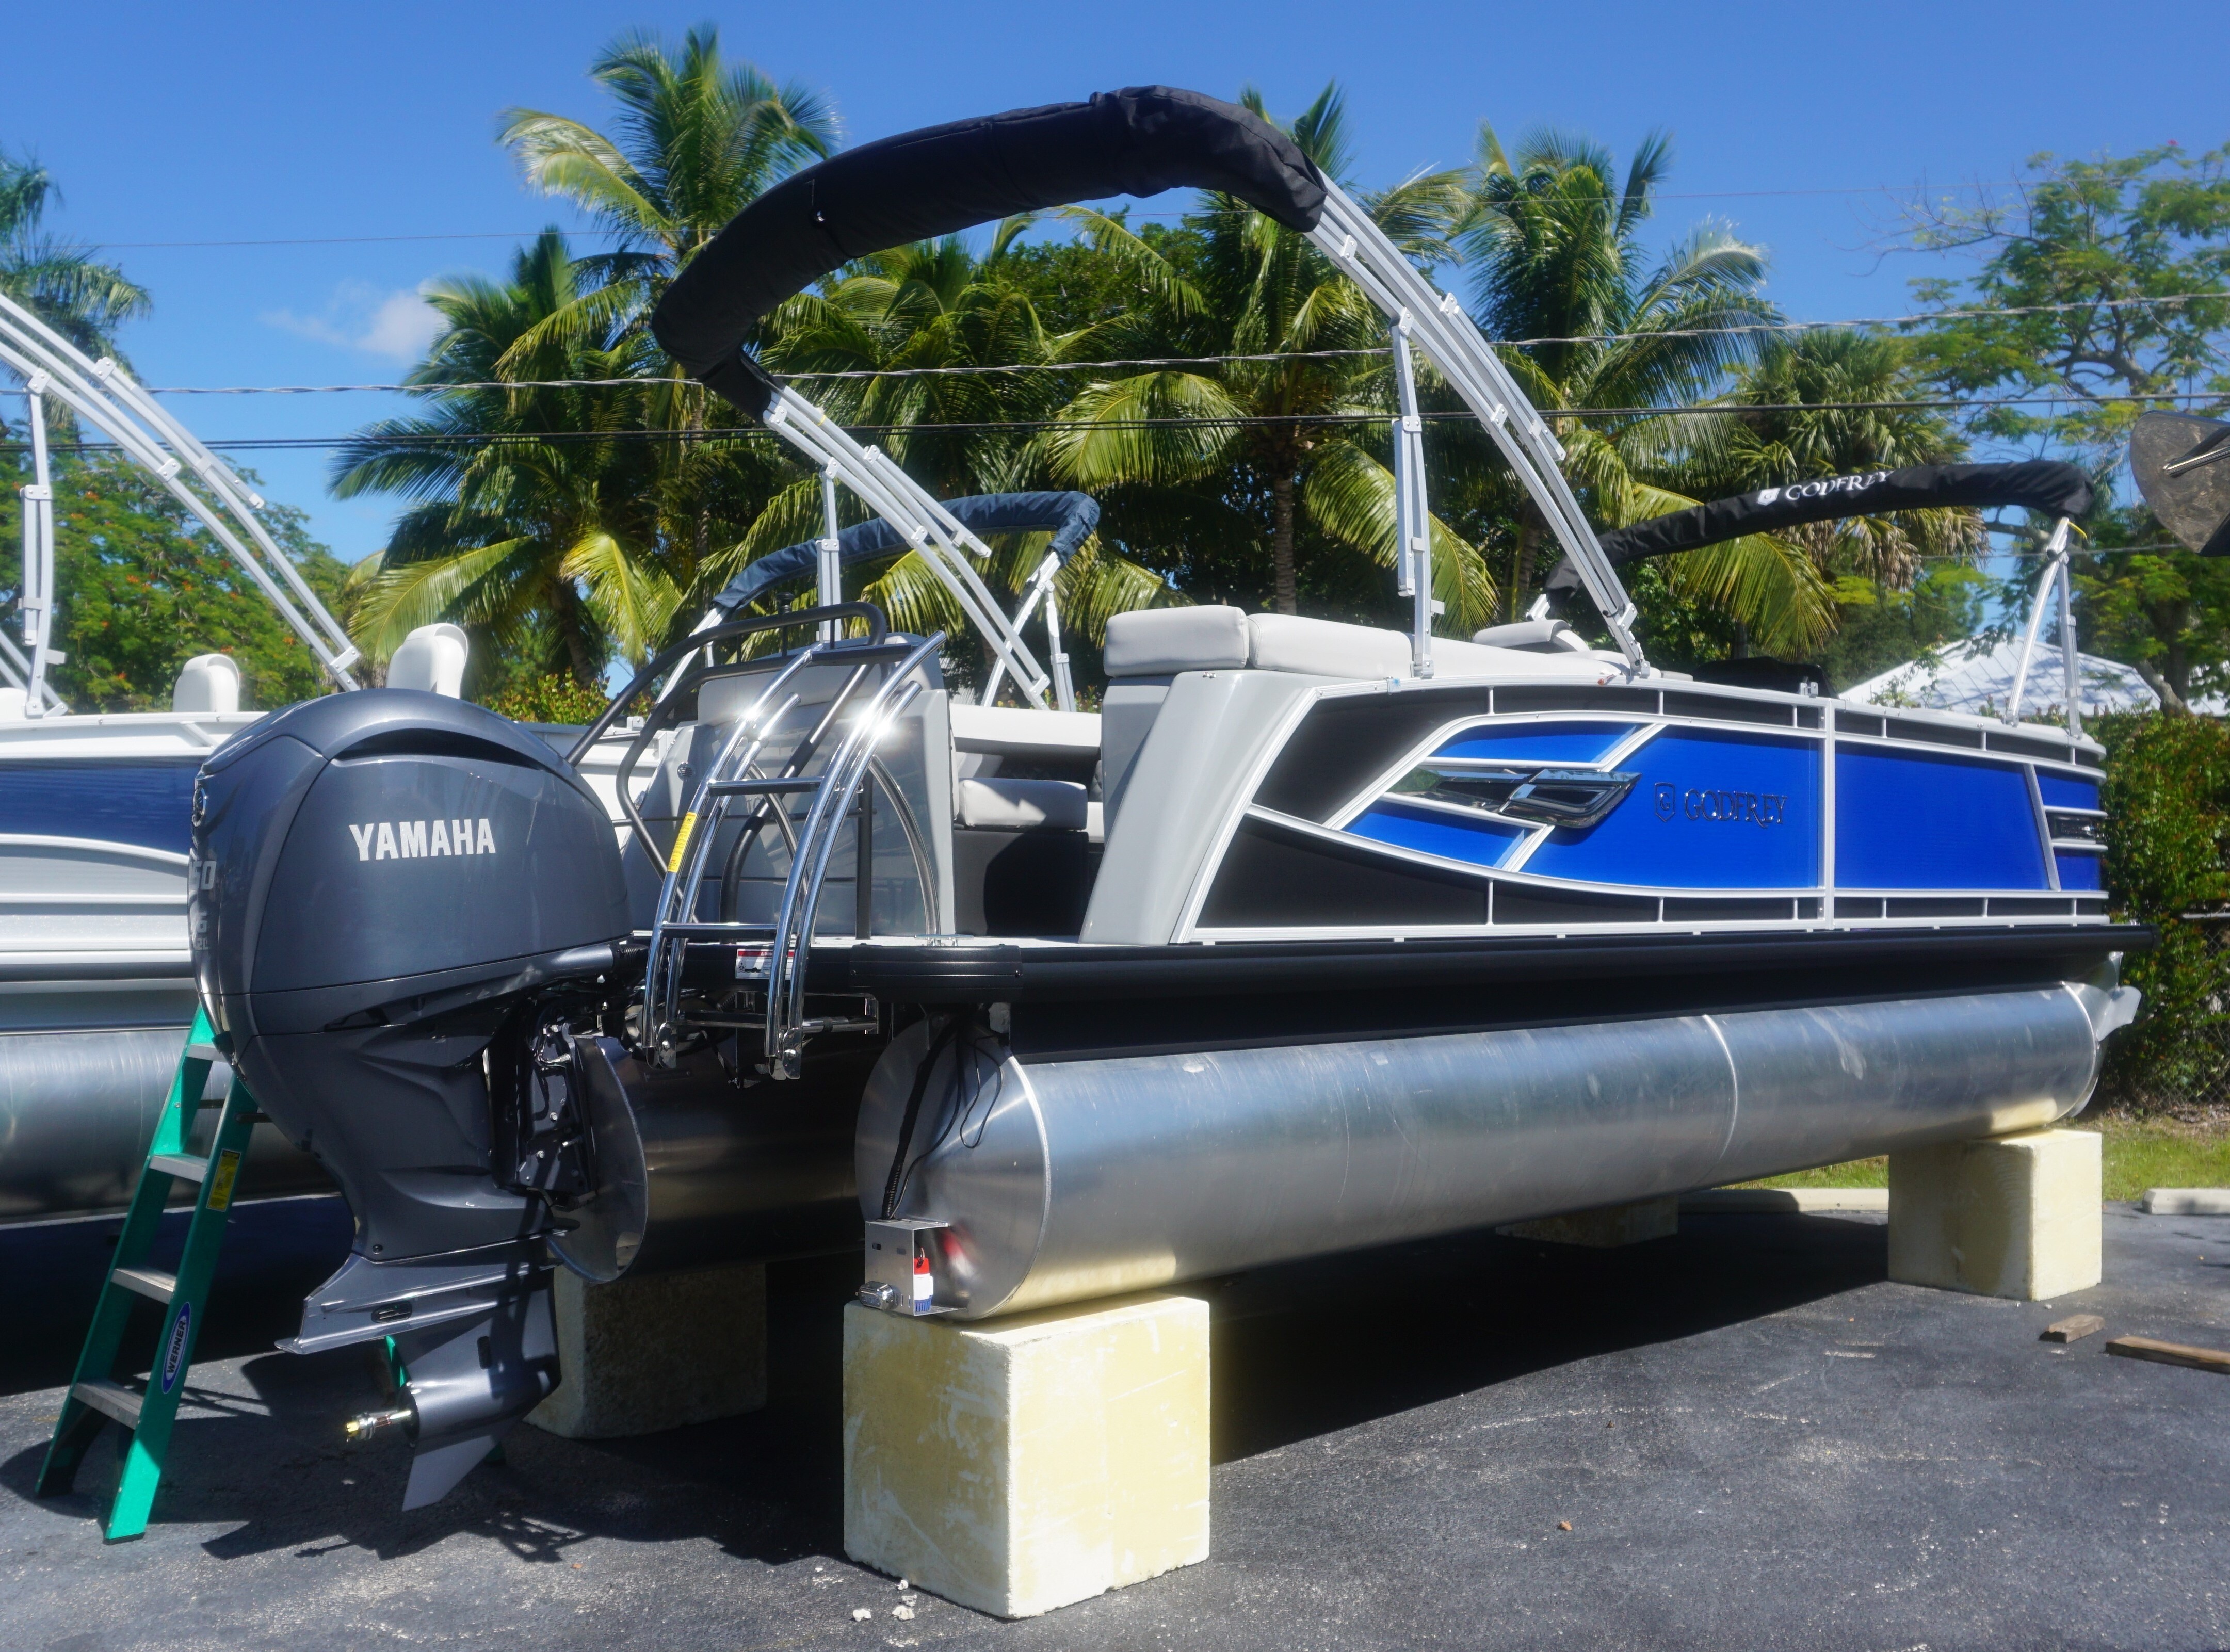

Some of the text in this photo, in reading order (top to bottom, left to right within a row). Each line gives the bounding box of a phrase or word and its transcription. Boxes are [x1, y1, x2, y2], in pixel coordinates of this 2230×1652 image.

[1785, 471, 1894, 501] GODFREY
[1685, 789, 1788, 828] GODFREY
[349, 818, 496, 861] YAMAHA
[167, 1320, 186, 1373] WERNER
